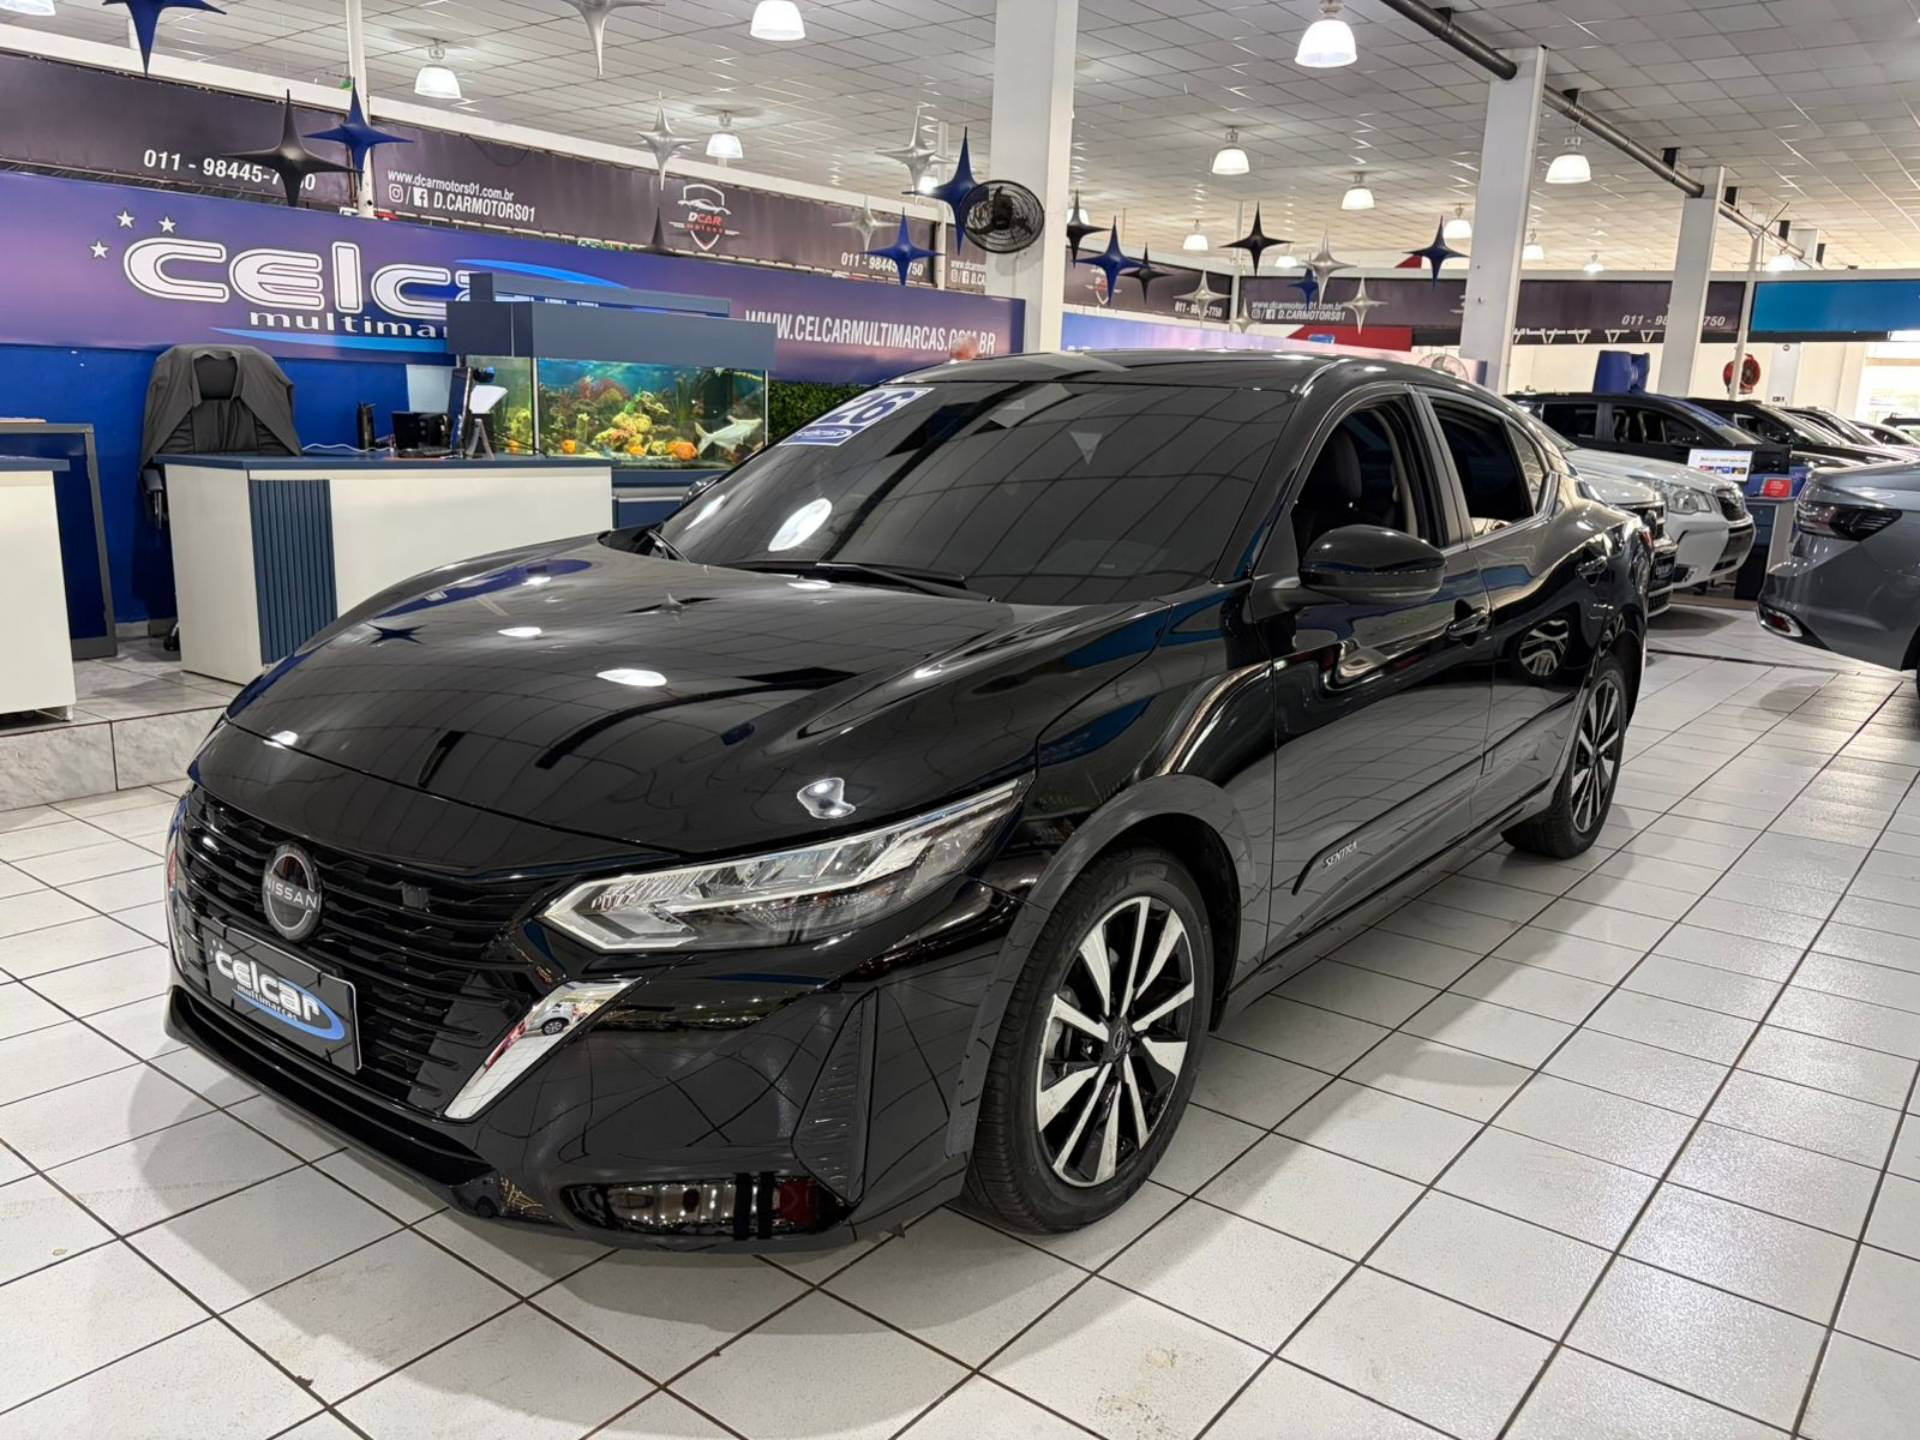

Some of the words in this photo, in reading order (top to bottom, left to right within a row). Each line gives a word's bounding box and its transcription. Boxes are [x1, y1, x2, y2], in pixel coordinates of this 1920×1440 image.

[144, 149, 181, 171] 011
[203, 157, 316, 191] 98445-70
[388, 169, 514, 201] www.dcarmotors01.com.br
[434, 192, 535, 222] D.CARMOTORS01
[688, 211, 722, 226] DCAR
[840, 252, 859, 267] 011
[1621, 314, 1644, 326] 011
[265, 874, 318, 909] NISSAN
